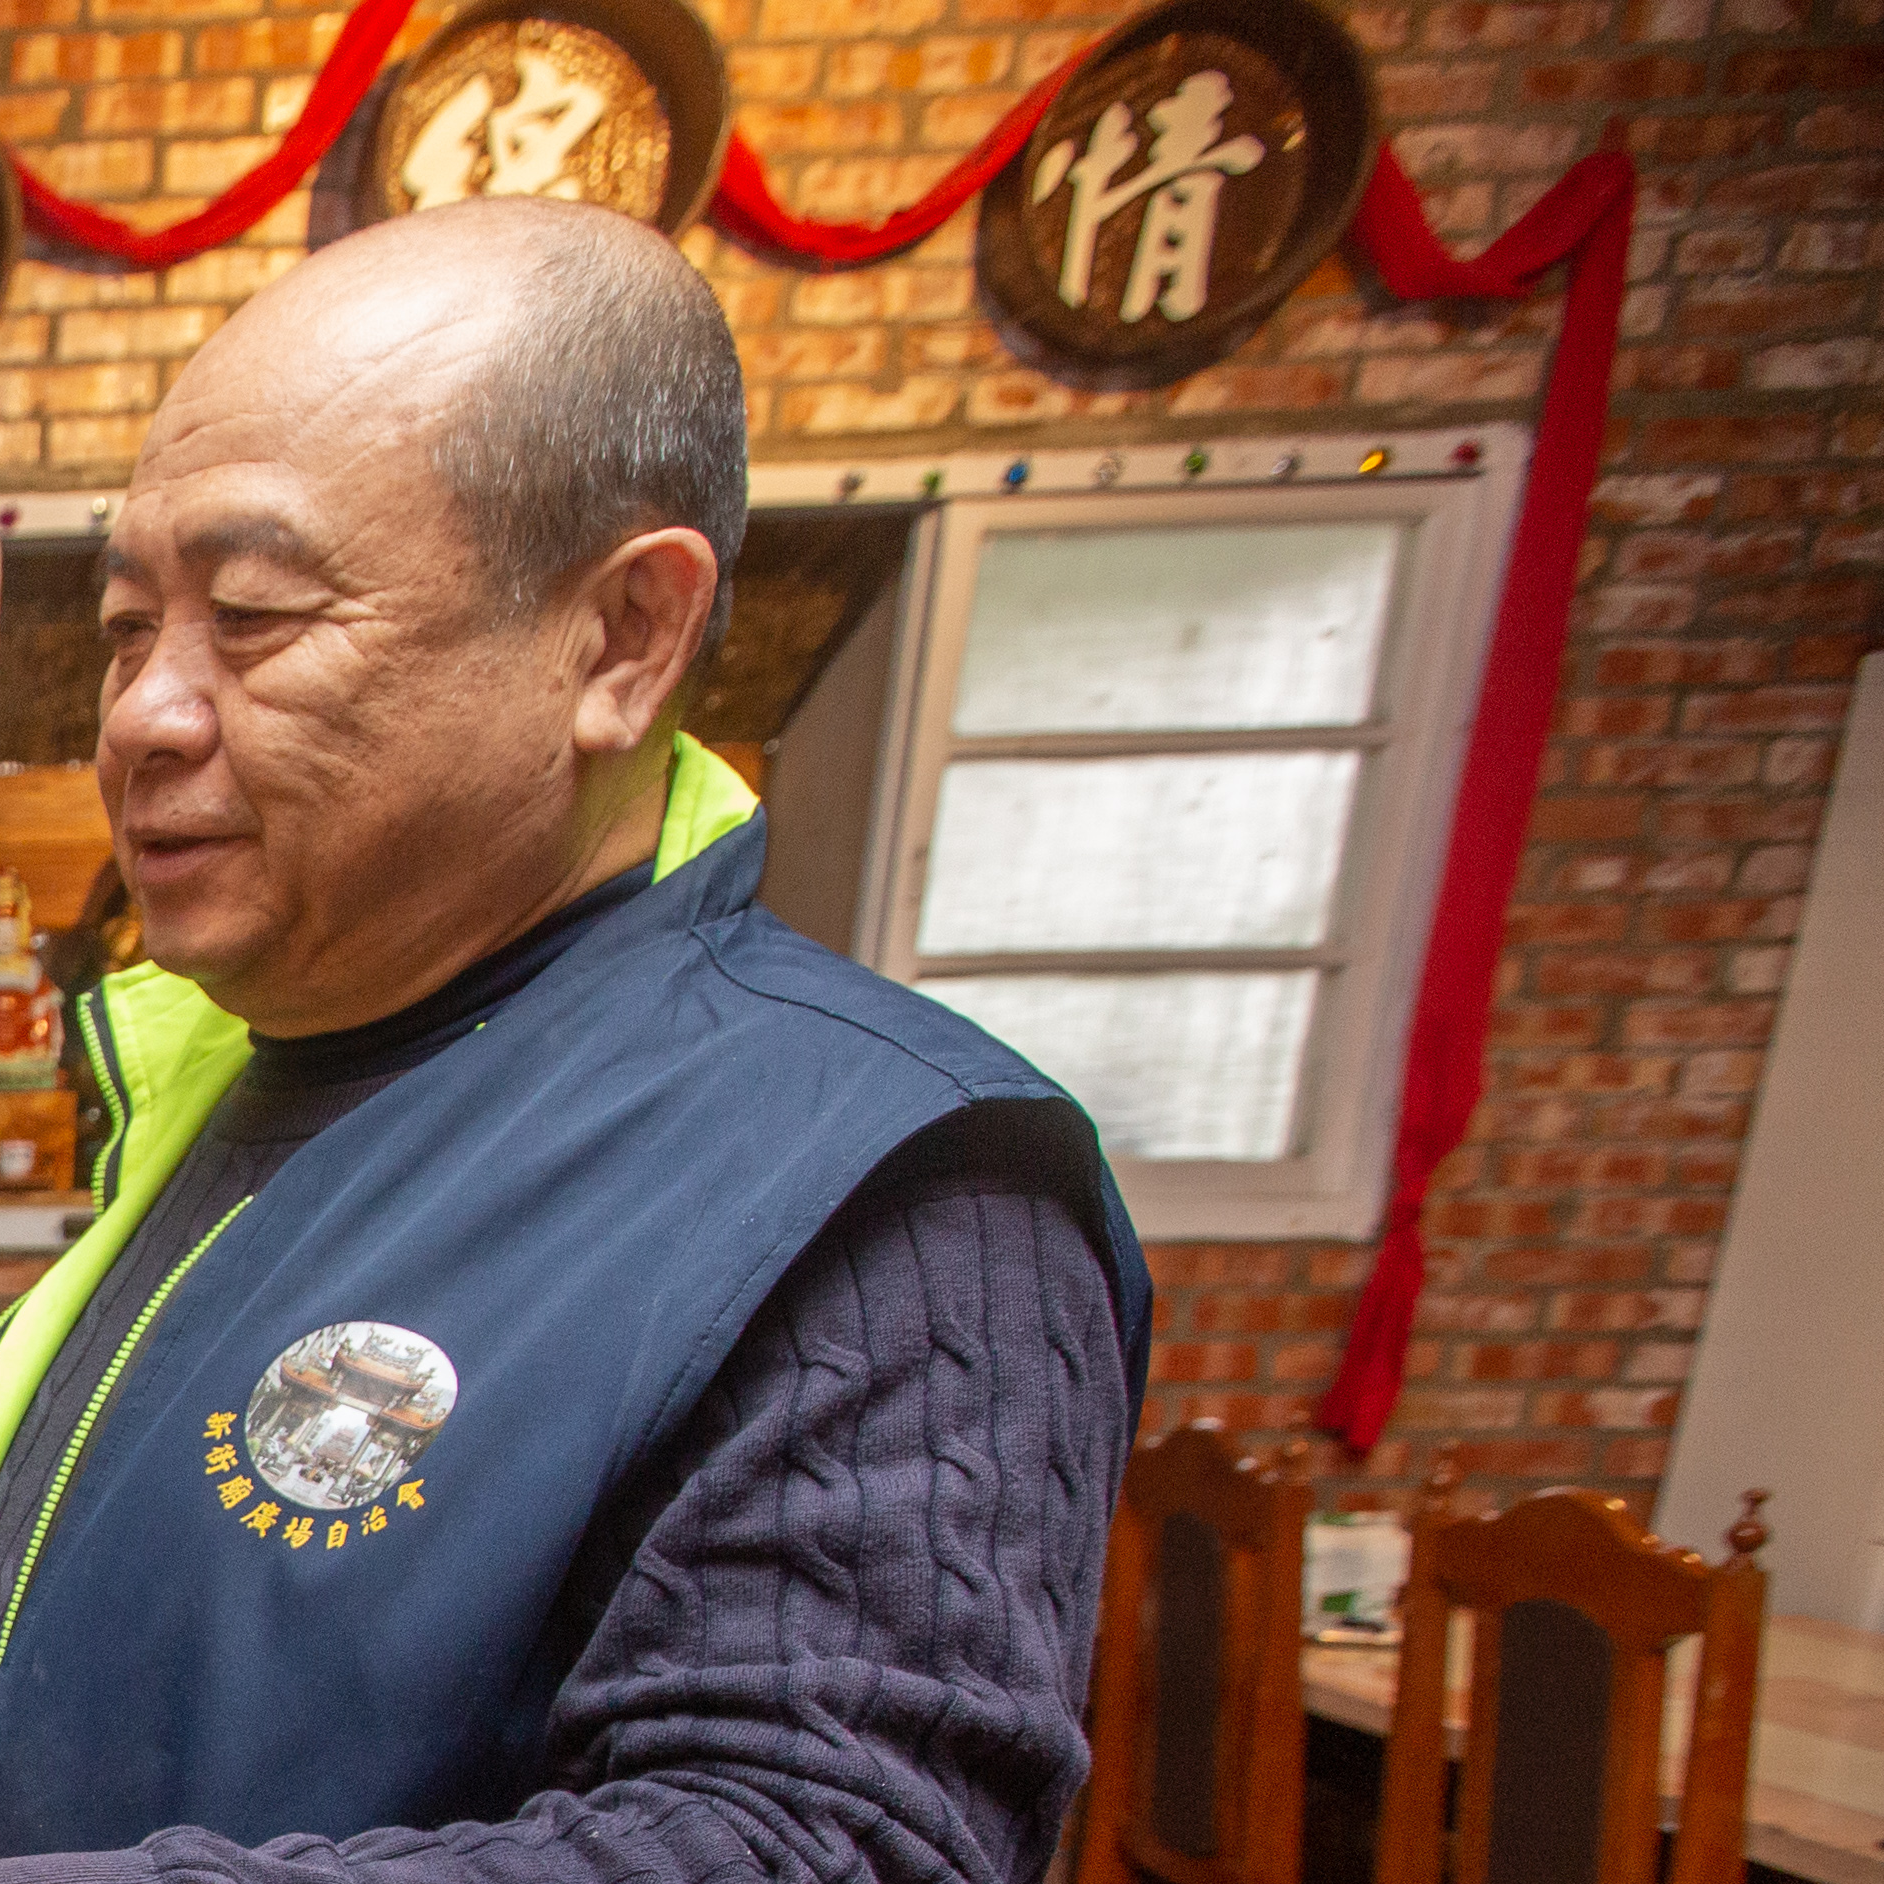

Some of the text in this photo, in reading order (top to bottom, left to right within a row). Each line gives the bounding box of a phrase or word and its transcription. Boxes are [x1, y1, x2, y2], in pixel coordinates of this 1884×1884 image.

[1032, 68, 1267, 323] 情
[202, 1411, 426, 1550] 新街廟廣場自治會
